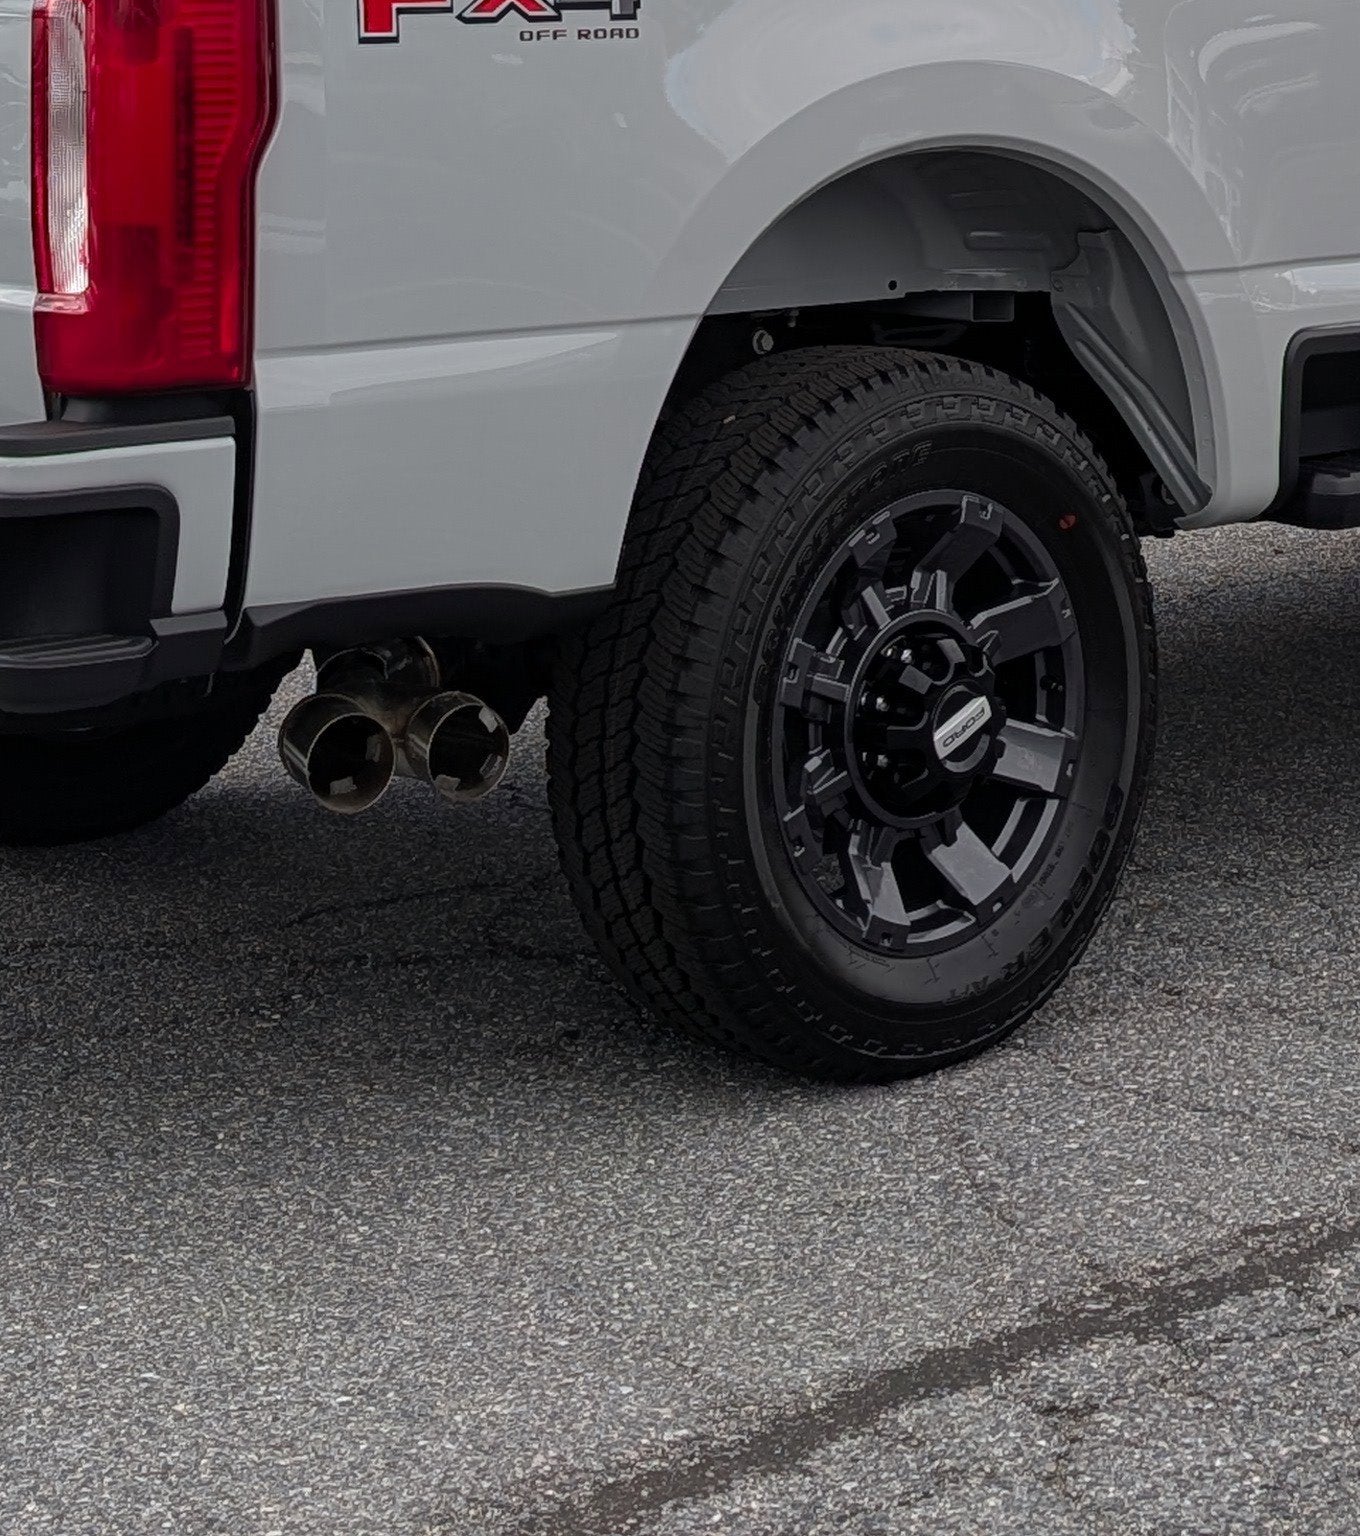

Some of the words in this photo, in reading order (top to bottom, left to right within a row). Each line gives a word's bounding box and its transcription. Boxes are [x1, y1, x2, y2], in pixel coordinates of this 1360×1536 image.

[519, 29, 568, 42] OFF
[577, 26, 639, 41] ROAD
[943, 706, 985, 748] FORD
